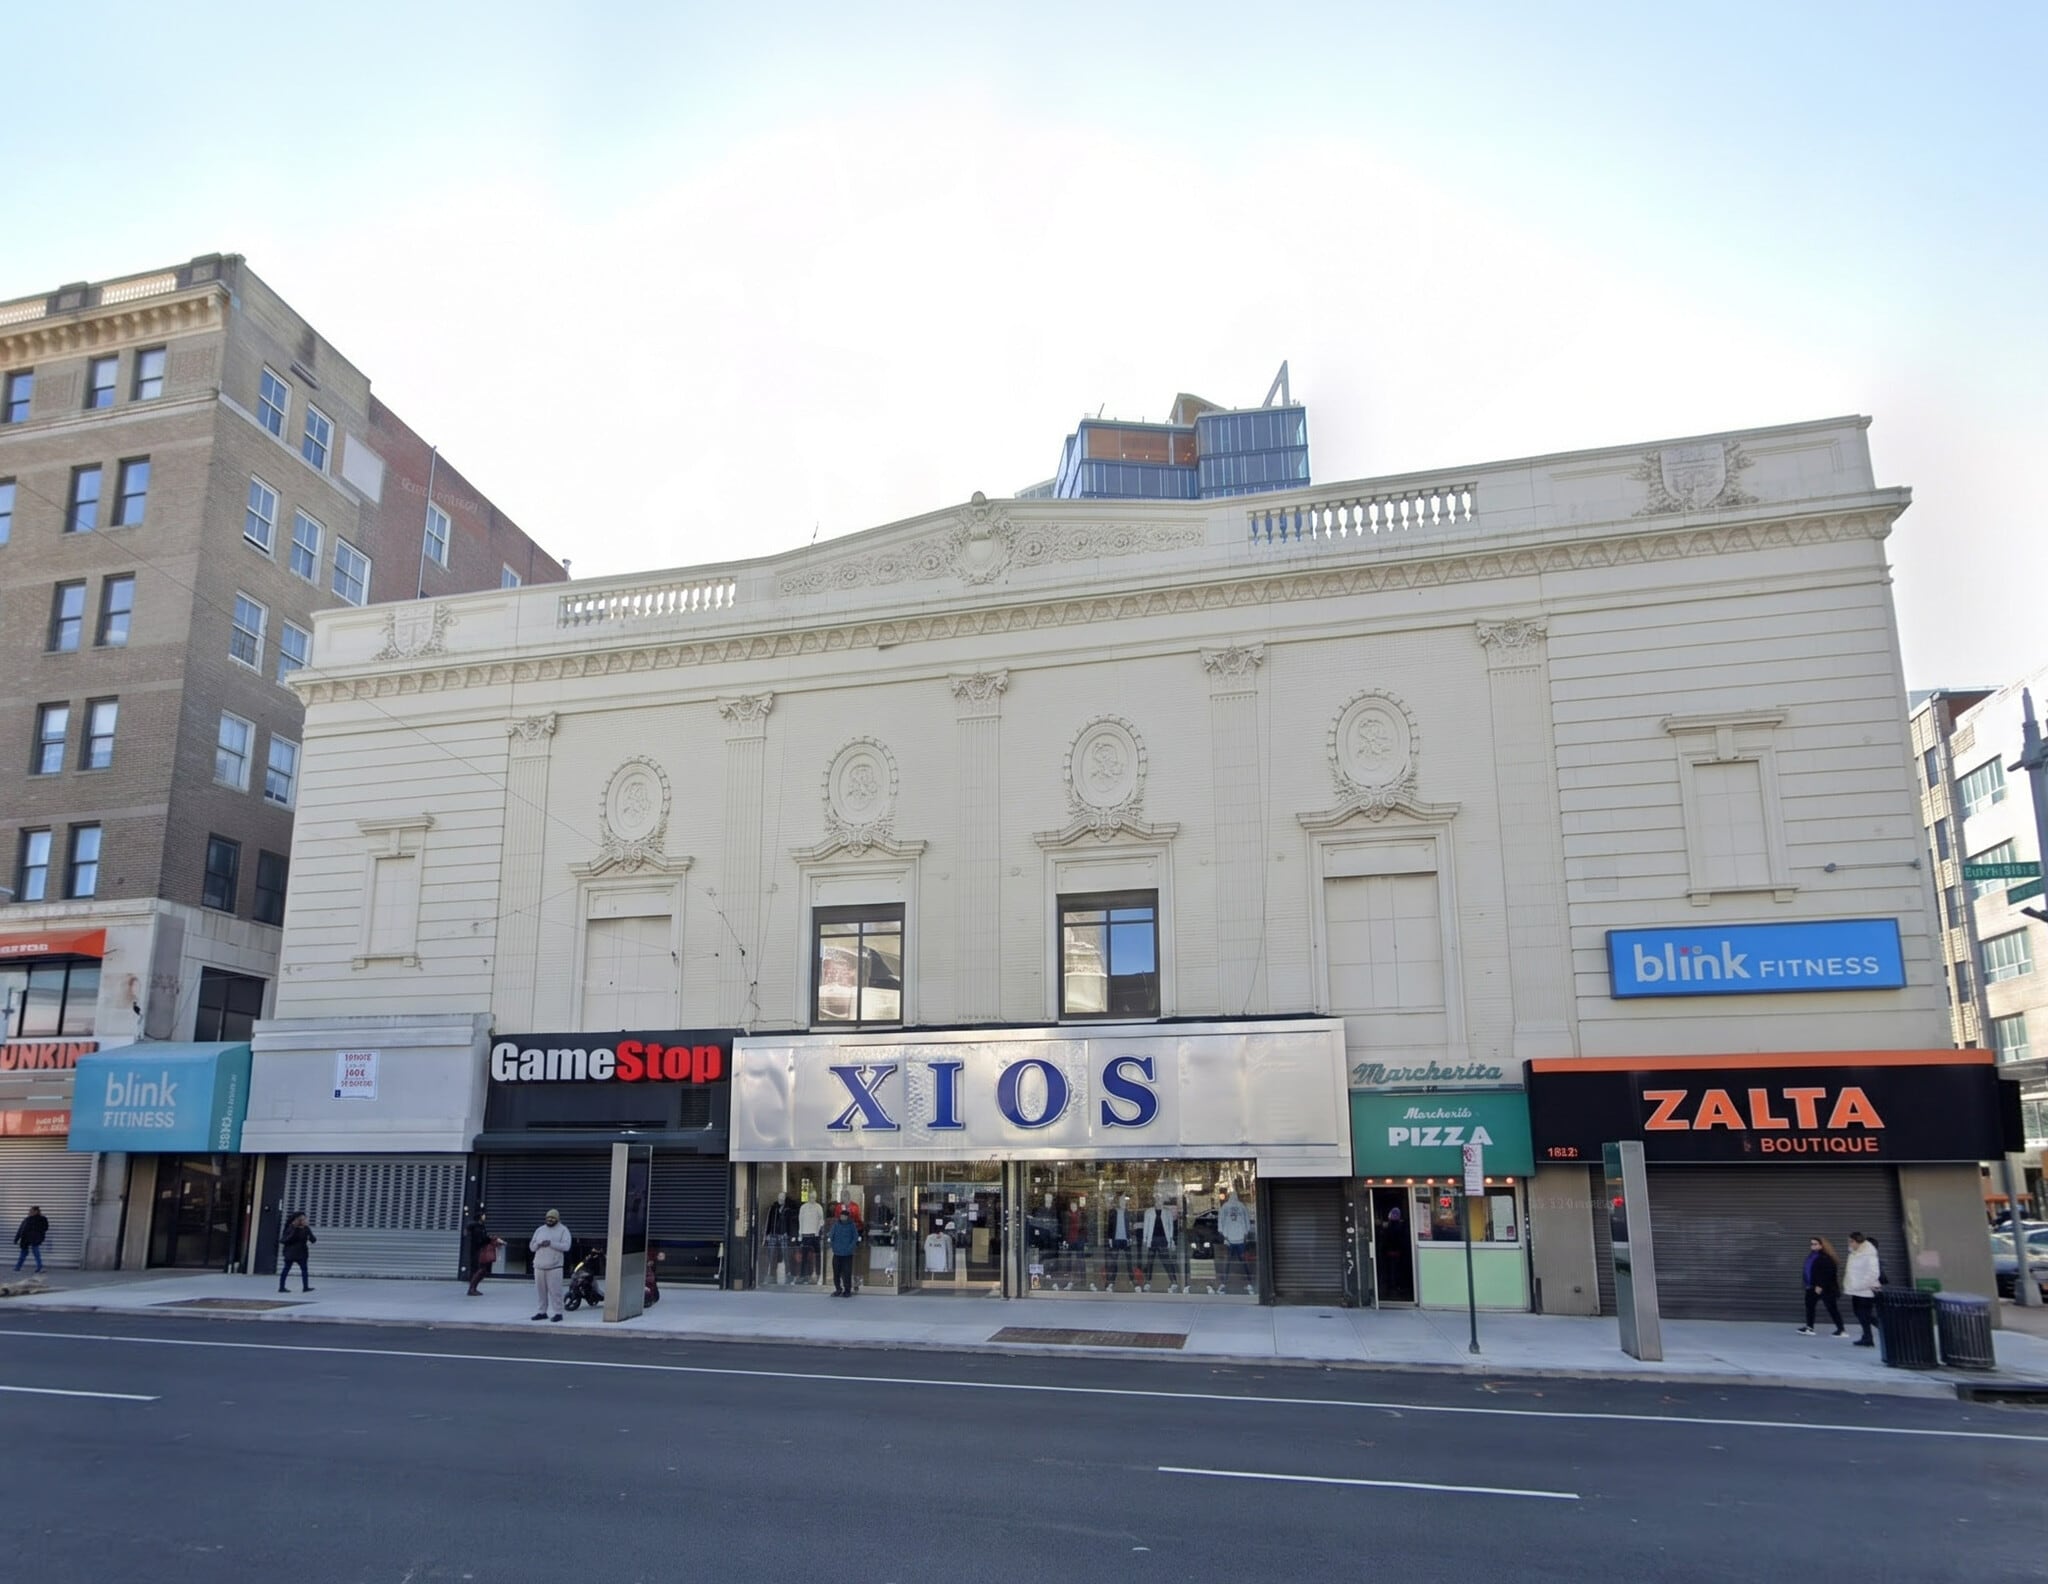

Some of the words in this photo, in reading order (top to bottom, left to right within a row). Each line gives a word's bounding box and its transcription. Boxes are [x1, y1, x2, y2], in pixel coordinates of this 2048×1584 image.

[1633, 941, 1751, 982] blink
[1759, 956, 1880, 978] FITNESS
[491, 1040, 722, 1084] GameStop
[105, 1071, 177, 1107] blink
[826, 1055, 1159, 1132] XIOS
[1643, 1087, 1885, 1131] ZALTA
[1388, 1126, 1494, 1146] PIZZA
[1760, 1137, 1879, 1153] BOUTIQUE
